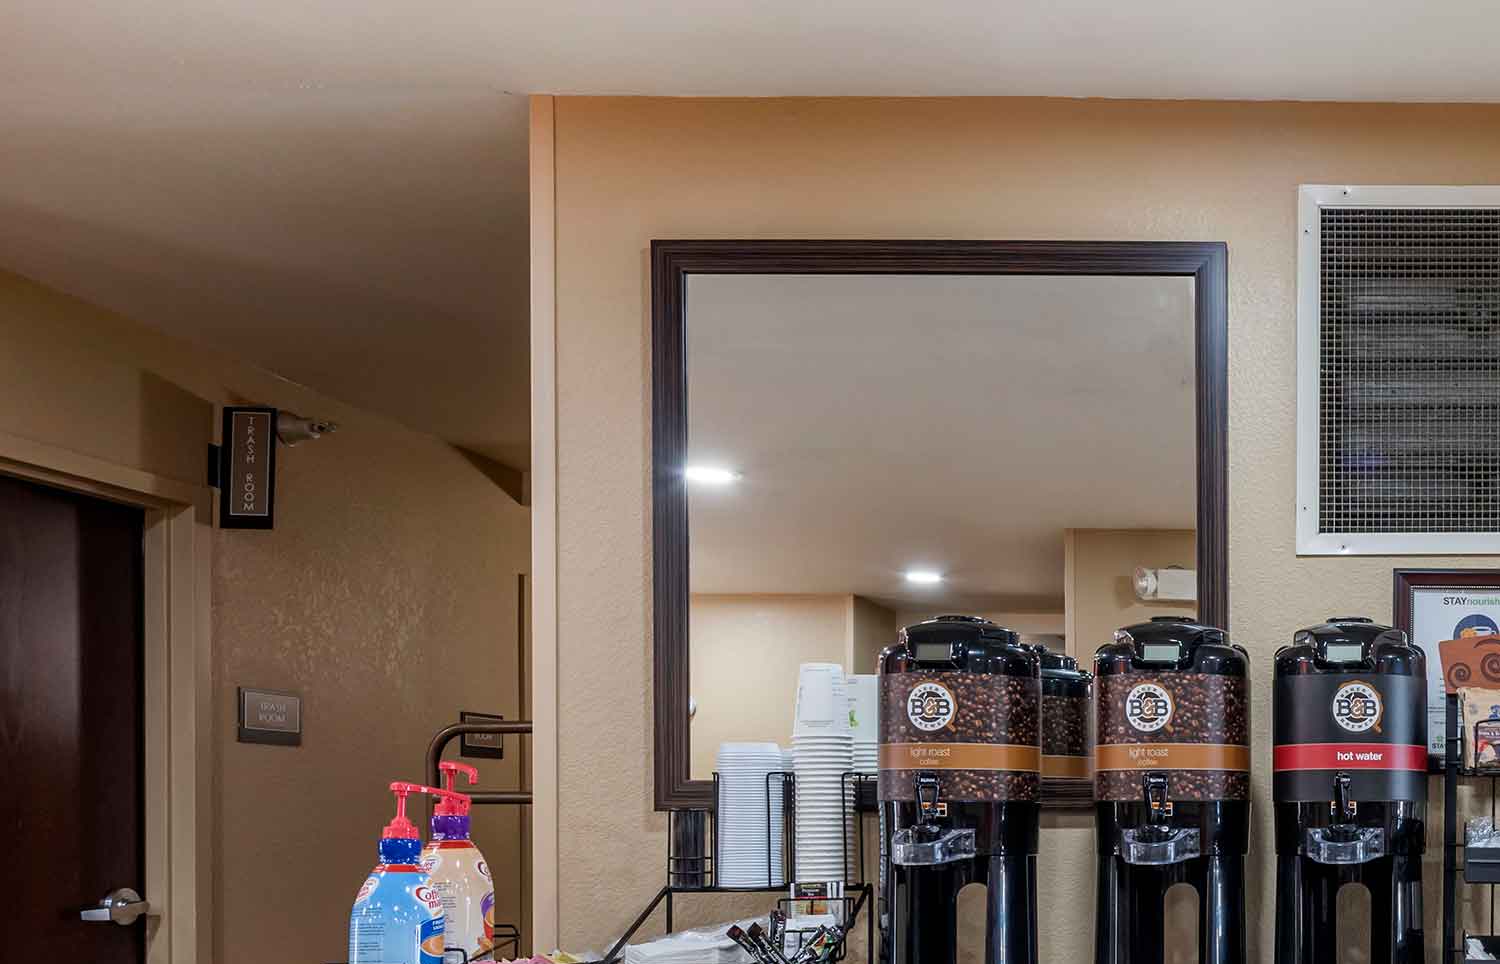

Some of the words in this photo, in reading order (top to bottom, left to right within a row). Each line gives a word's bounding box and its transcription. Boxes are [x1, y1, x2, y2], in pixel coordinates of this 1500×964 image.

[246, 416, 257, 464] TRASH
[243, 472, 255, 511] ROOM
[911, 698, 951, 717] B&B
[1129, 698, 1169, 717] B&B
[1336, 698, 1377, 718] B&B
[1337, 752, 1354, 761] hot
[1355, 752, 1383, 761] water
